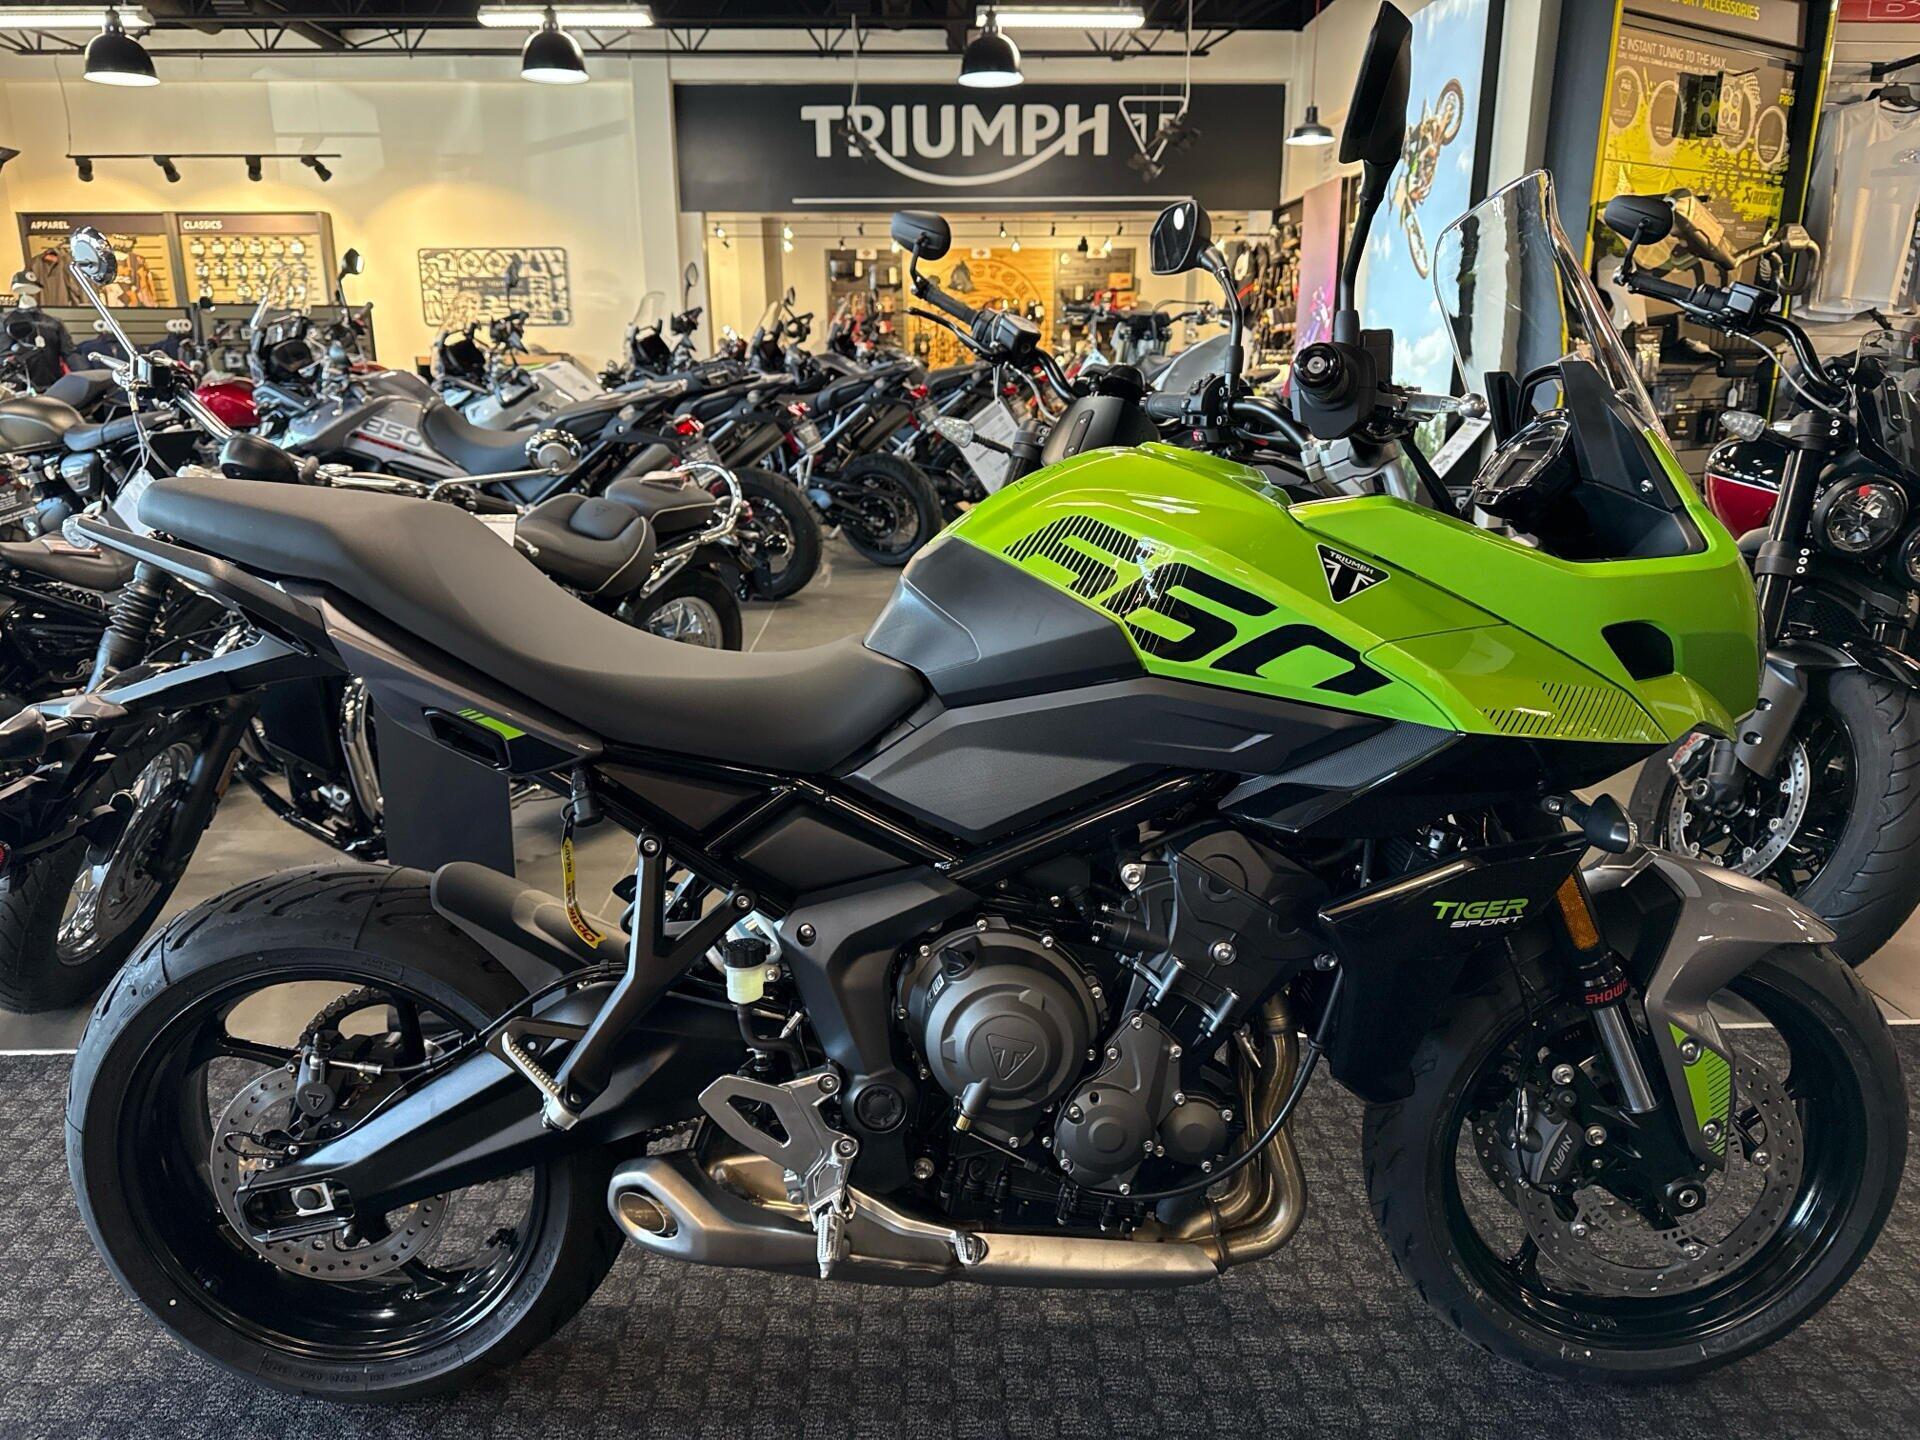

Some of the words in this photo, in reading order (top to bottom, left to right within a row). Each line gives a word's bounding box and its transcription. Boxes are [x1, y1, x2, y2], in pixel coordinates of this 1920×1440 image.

[1627, 38, 1658, 54] INSTANT
[1658, 44, 1684, 60] TUNING
[1685, 50, 1695, 63] TO
[1696, 52, 1710, 66] THE
[1710, 56, 1727, 69] MAX
[800, 103, 1110, 186] TRIUMPH
[30, 221, 70, 230] APPAREL
[183, 220, 222, 230] CLASSICS
[1330, 550, 1375, 575] TRIUMPH
[1432, 898, 1529, 920] TIGER
[1450, 915, 1525, 929] SPORT
[1584, 978, 1630, 1005] SHOWA
